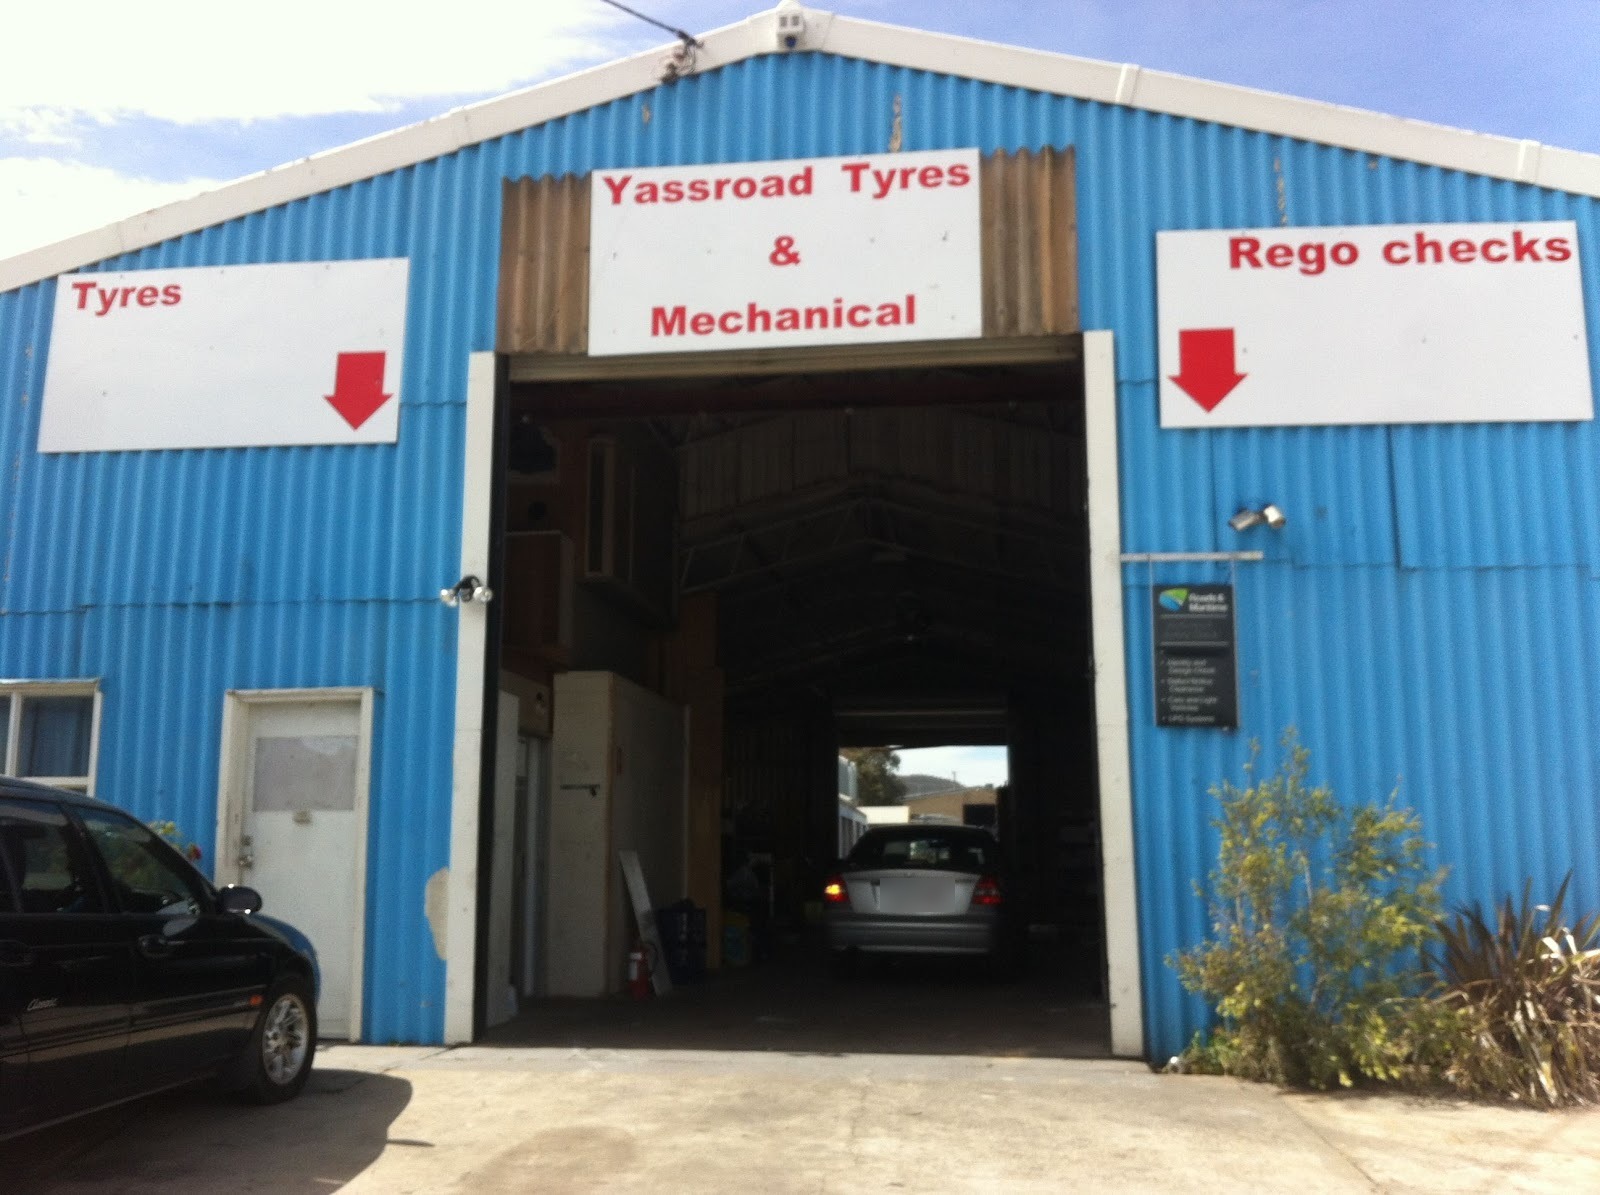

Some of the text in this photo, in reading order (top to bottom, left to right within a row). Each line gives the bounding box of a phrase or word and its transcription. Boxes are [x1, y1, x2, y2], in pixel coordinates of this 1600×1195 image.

[603, 162, 971, 205] Yassroad Tyres
[769, 235, 801, 266] &
[1229, 230, 1572, 275] Rego checks
[72, 281, 181, 316] Tyres
[650, 294, 916, 337] Mechanical
